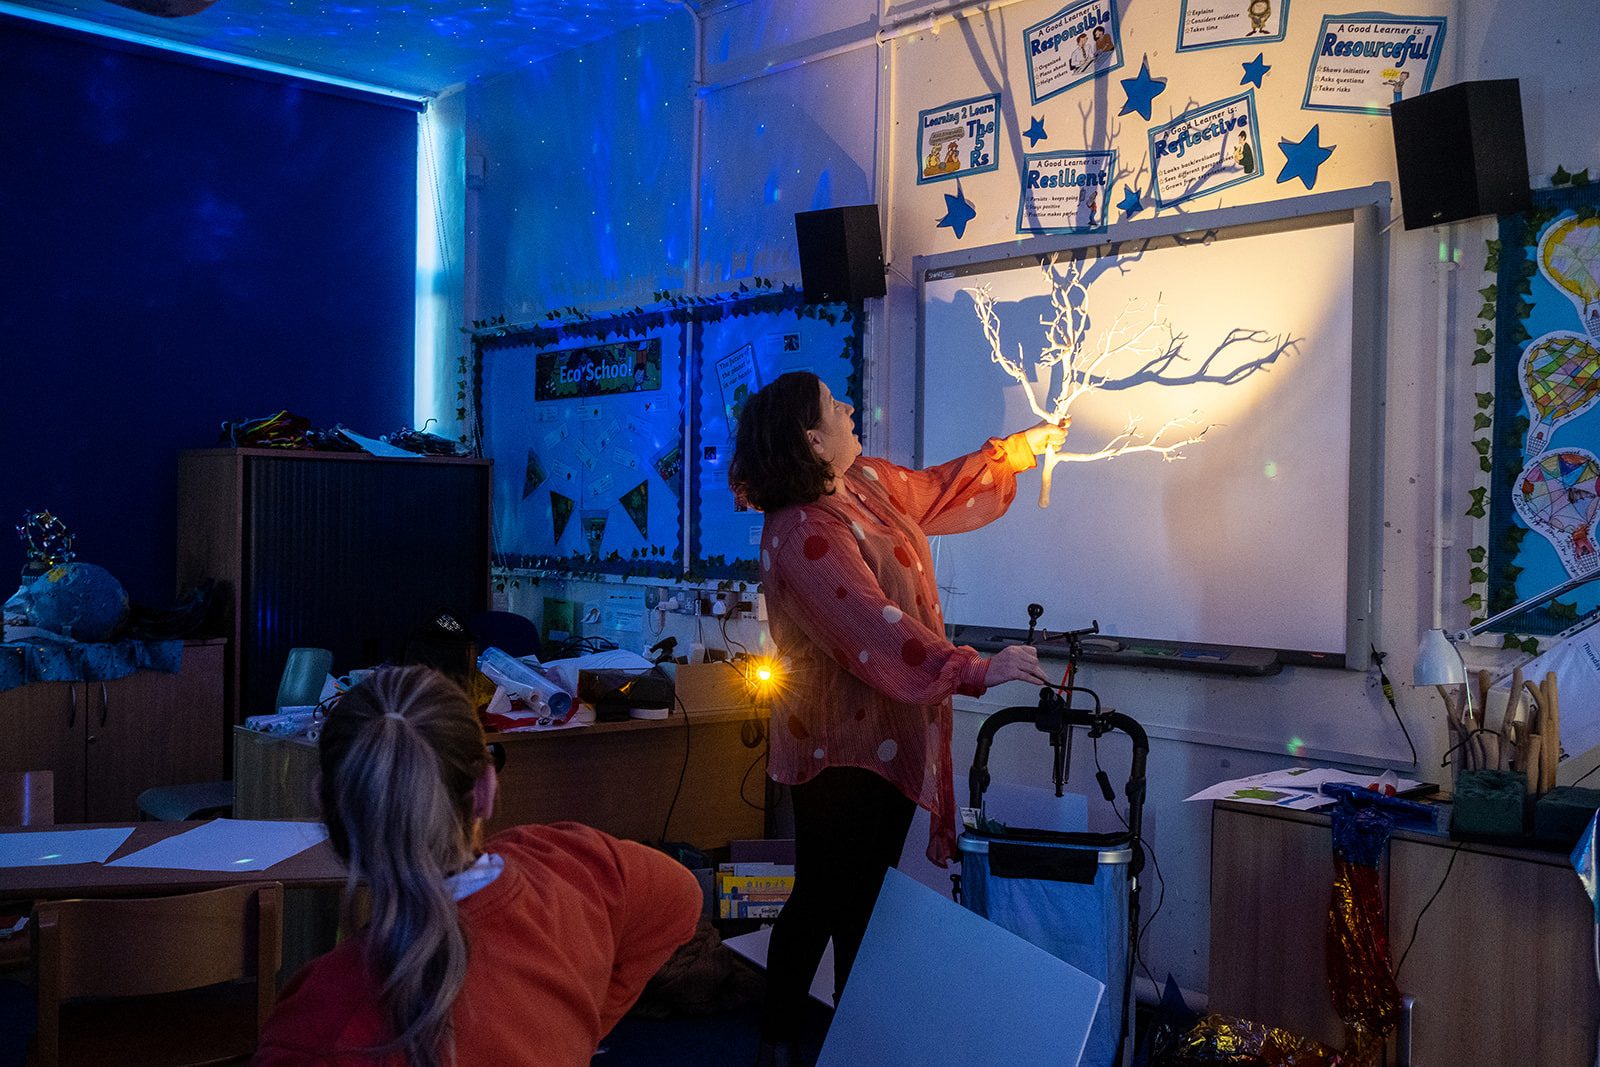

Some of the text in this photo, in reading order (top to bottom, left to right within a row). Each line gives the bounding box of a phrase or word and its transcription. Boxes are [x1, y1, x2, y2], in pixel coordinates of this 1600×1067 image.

[1045, 21, 1063, 34] Good
[1064, 8, 1090, 24] Learner
[1192, 9, 1214, 17] Explains
[1217, 13, 1240, 21] evidence
[1031, 9, 1110, 56] Responsible
[1348, 25, 1371, 33] Good
[1374, 25, 1411, 34] Learner
[1413, 26, 1424, 35] is:
[1321, 33, 1432, 68] Resourceful
[1039, 62, 1066, 78] Plans ahead
[1040, 70, 1068, 86] Helps others
[924, 104, 994, 128] Learning 2 Learn
[1171, 124, 1192, 135] Good
[1194, 111, 1225, 124] Learner
[967, 119, 994, 138] The
[1155, 115, 1247, 158] Reflective
[975, 135, 984, 151] 5
[970, 151, 989, 167] Rs
[1027, 168, 1107, 189] Resilient
[1164, 166, 1180, 175] Looks
[1166, 167, 1226, 190] Grows from experience
[1177, 167, 1200, 178] different
[560, 356, 633, 383] Eco School
